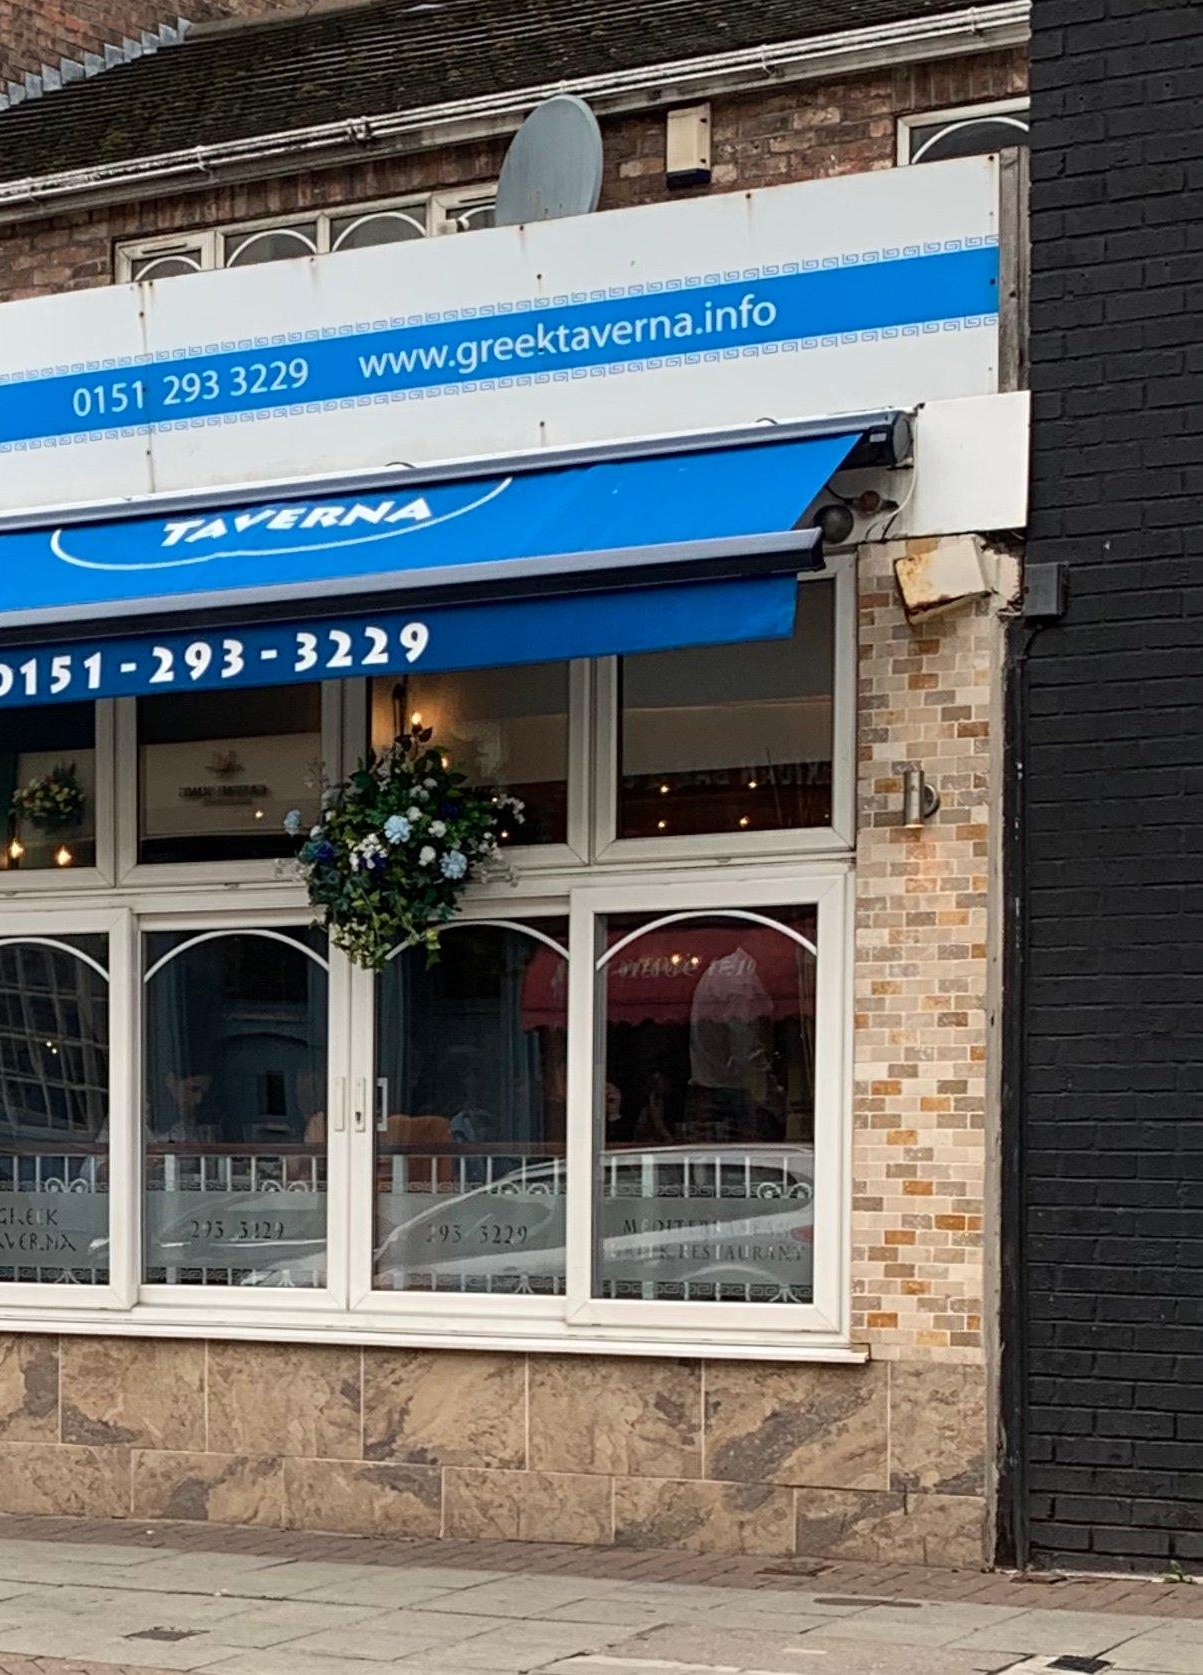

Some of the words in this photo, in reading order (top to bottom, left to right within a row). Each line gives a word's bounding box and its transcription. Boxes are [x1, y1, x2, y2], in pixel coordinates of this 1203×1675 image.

[71, 379, 147, 418] 0151
[162, 368, 221, 407] 293
[229, 356, 310, 397] 3229
[358, 294, 778, 380] www.greektaverna.info
[161, 497, 434, 547] TAVERNA
[479, 1224, 528, 1244] 3229
